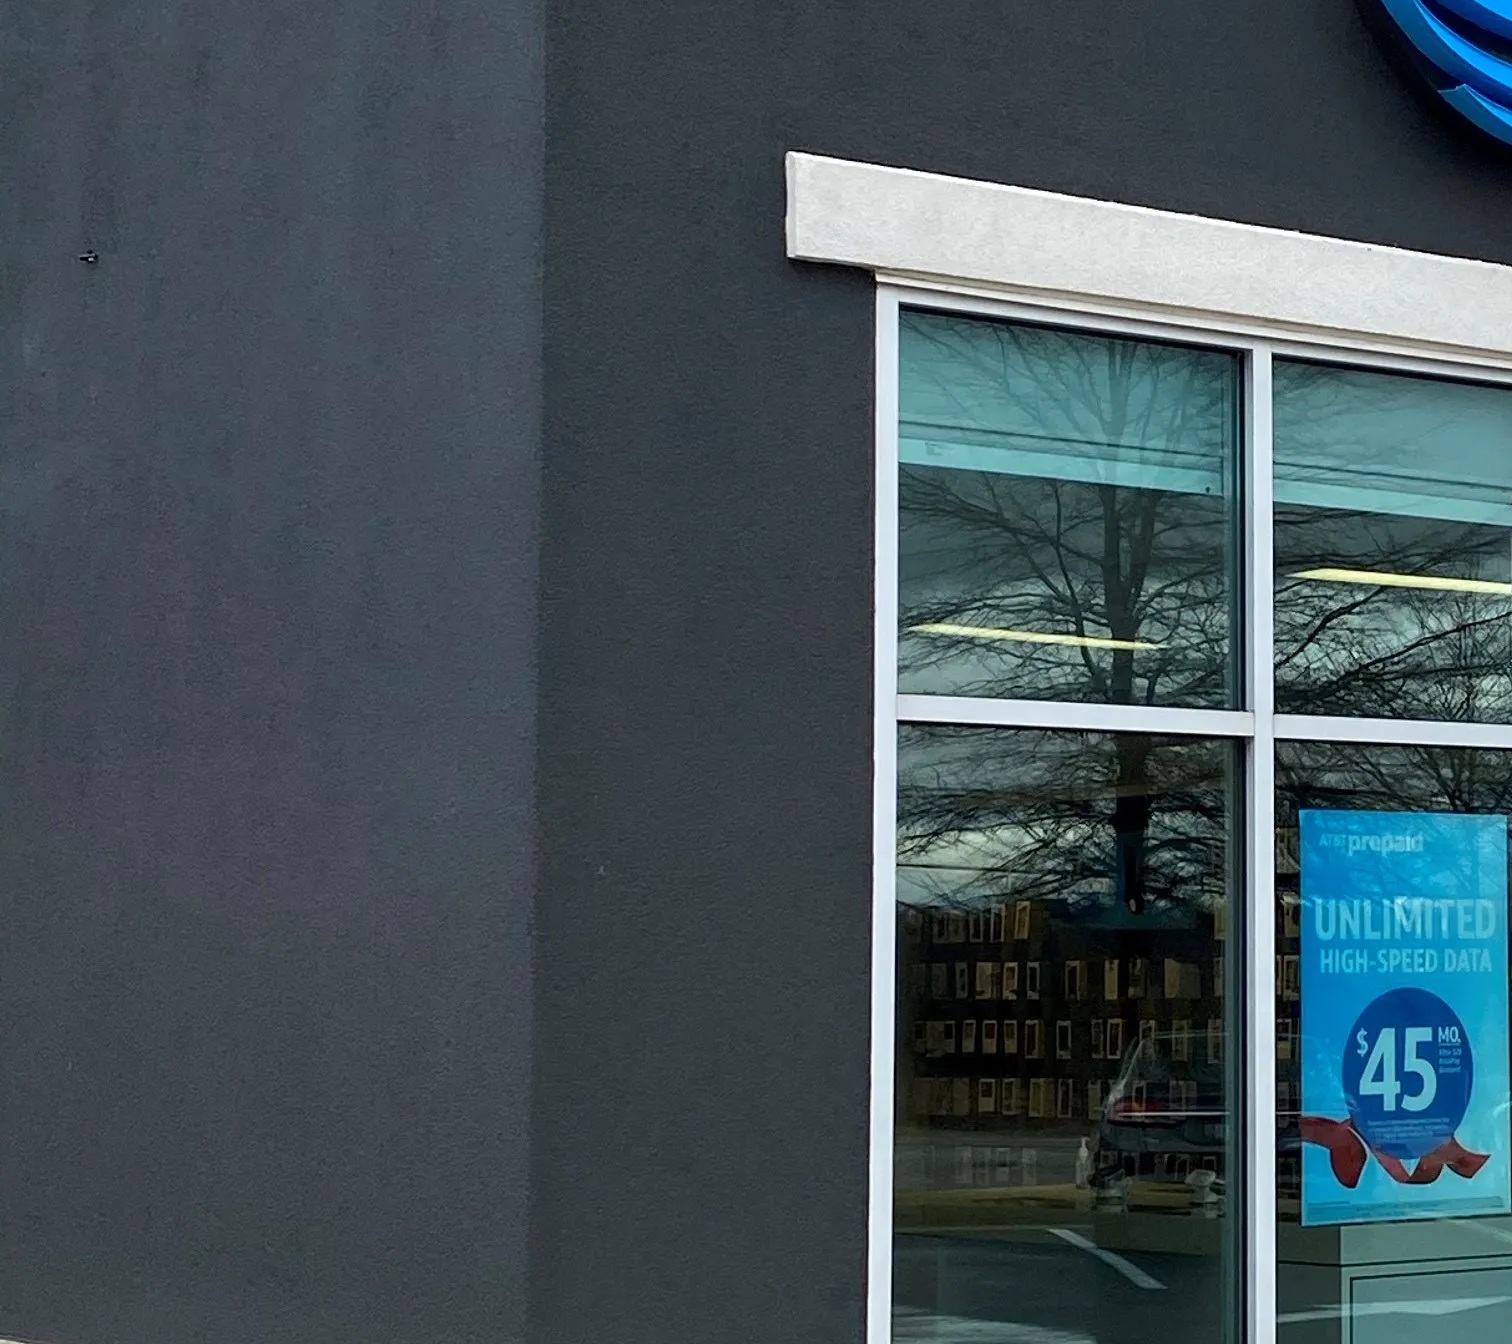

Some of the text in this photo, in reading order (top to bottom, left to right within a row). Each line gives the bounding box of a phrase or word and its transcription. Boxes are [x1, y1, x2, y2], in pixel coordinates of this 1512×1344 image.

[1348, 831, 1424, 857] prepaid
[1313, 896, 1497, 941] UNLIMITED
[1319, 948, 1493, 974] HIGH-SPEED DATA
